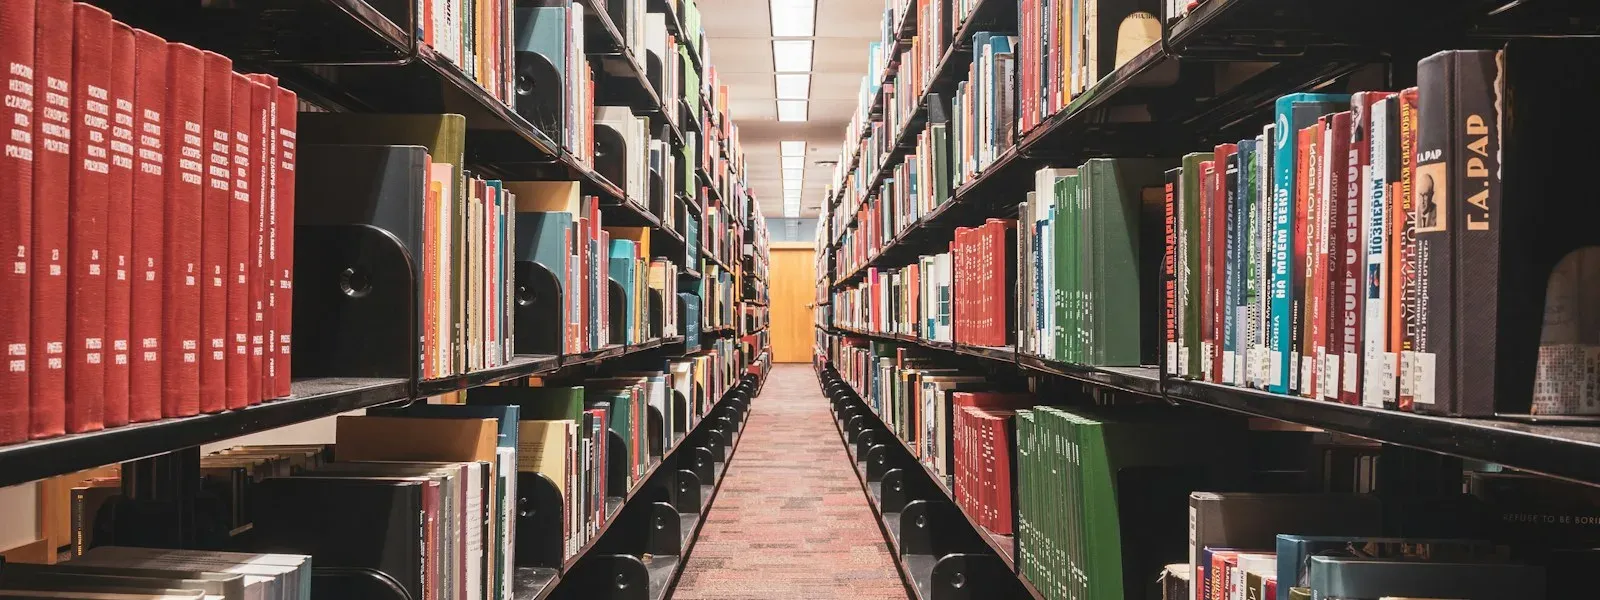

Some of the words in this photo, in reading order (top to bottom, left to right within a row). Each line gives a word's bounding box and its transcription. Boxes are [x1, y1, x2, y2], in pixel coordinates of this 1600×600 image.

[1402, 102, 1411, 138] ЛЮБВИ
[1402, 139, 1411, 164] СИЛА
[1403, 166, 1411, 209] ВЕЛИКАЯ
[1165, 182, 1174, 276] КОНДРАШОВ
[1226, 190, 1234, 260] АНГЕЛАМ
[1372, 177, 1384, 255] ПОЗНЕРОМ
[1276, 229, 1287, 275] МОЕМ
[1305, 224, 1314, 278] БОРИС
[1329, 233, 1337, 272] СУДЬБЕ
[1224, 261, 1233, 346] ПОДОБНЫЕ
[1275, 280, 1286, 299] НА
[1421, 277, 1429, 324] истории
[1543, 515, 1555, 523] TO
[1575, 516, 1600, 525] BORI
